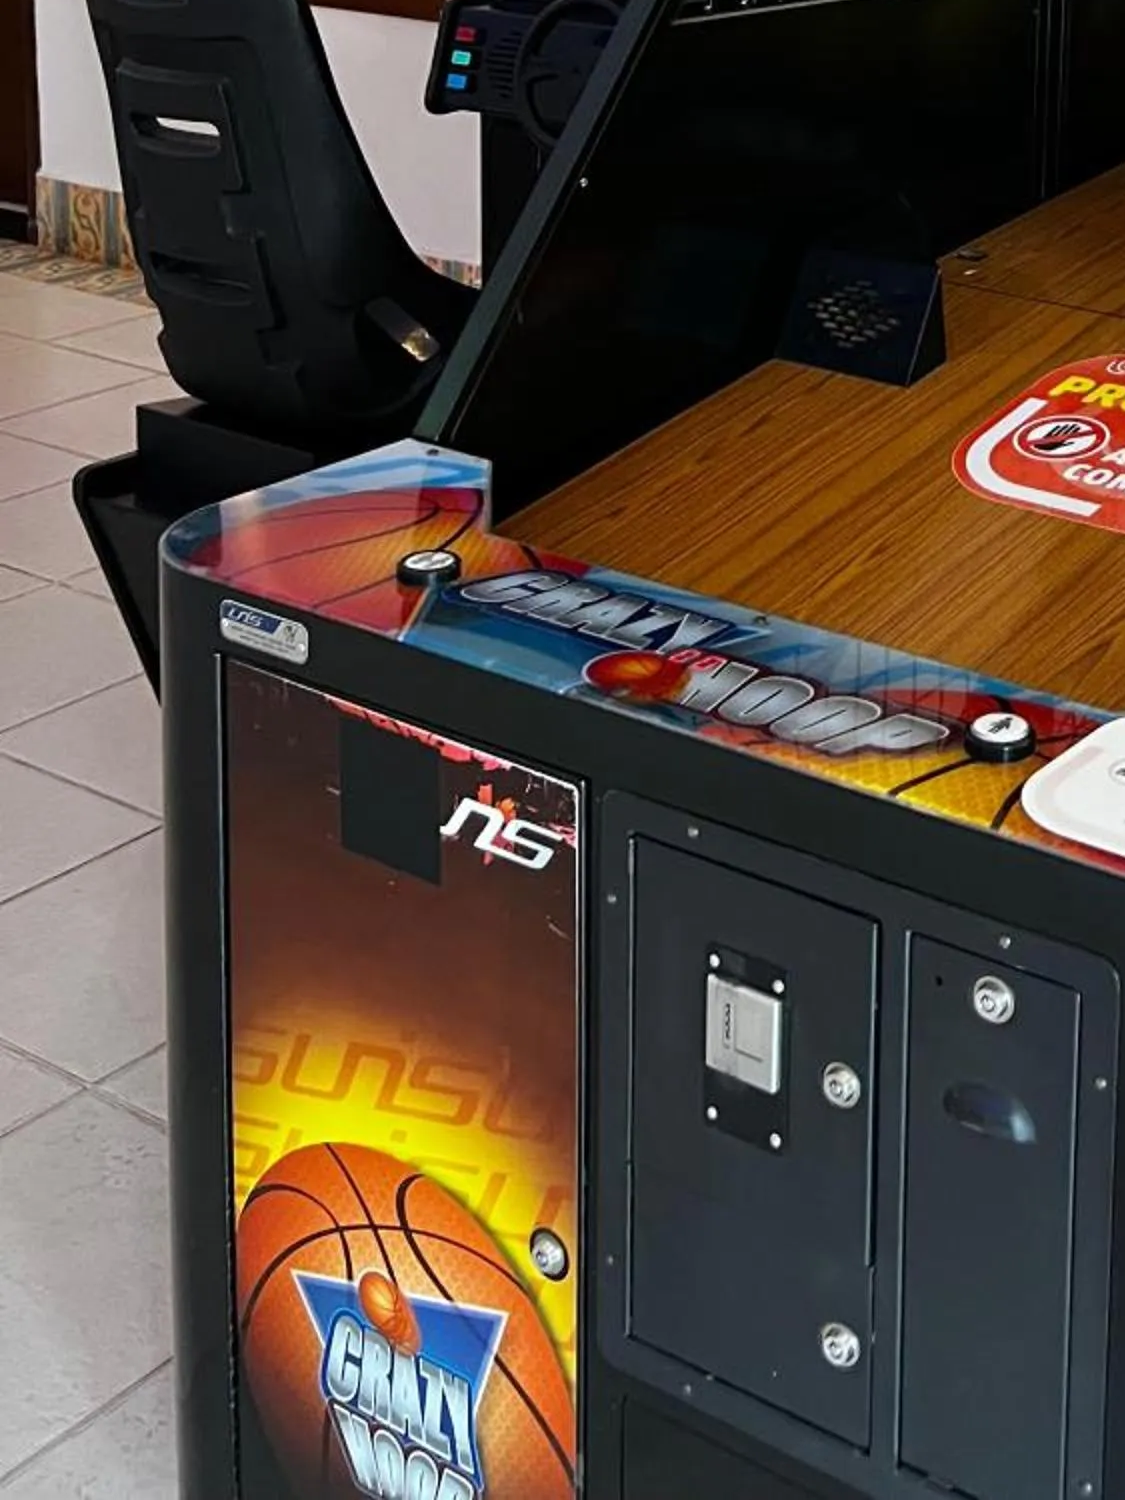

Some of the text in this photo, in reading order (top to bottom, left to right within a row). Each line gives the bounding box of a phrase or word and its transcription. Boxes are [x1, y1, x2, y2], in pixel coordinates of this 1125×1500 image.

[459, 571, 735, 654] CRAZY
[680, 660, 950, 754] HOOP
[325, 1314, 475, 1475] CRAZY
